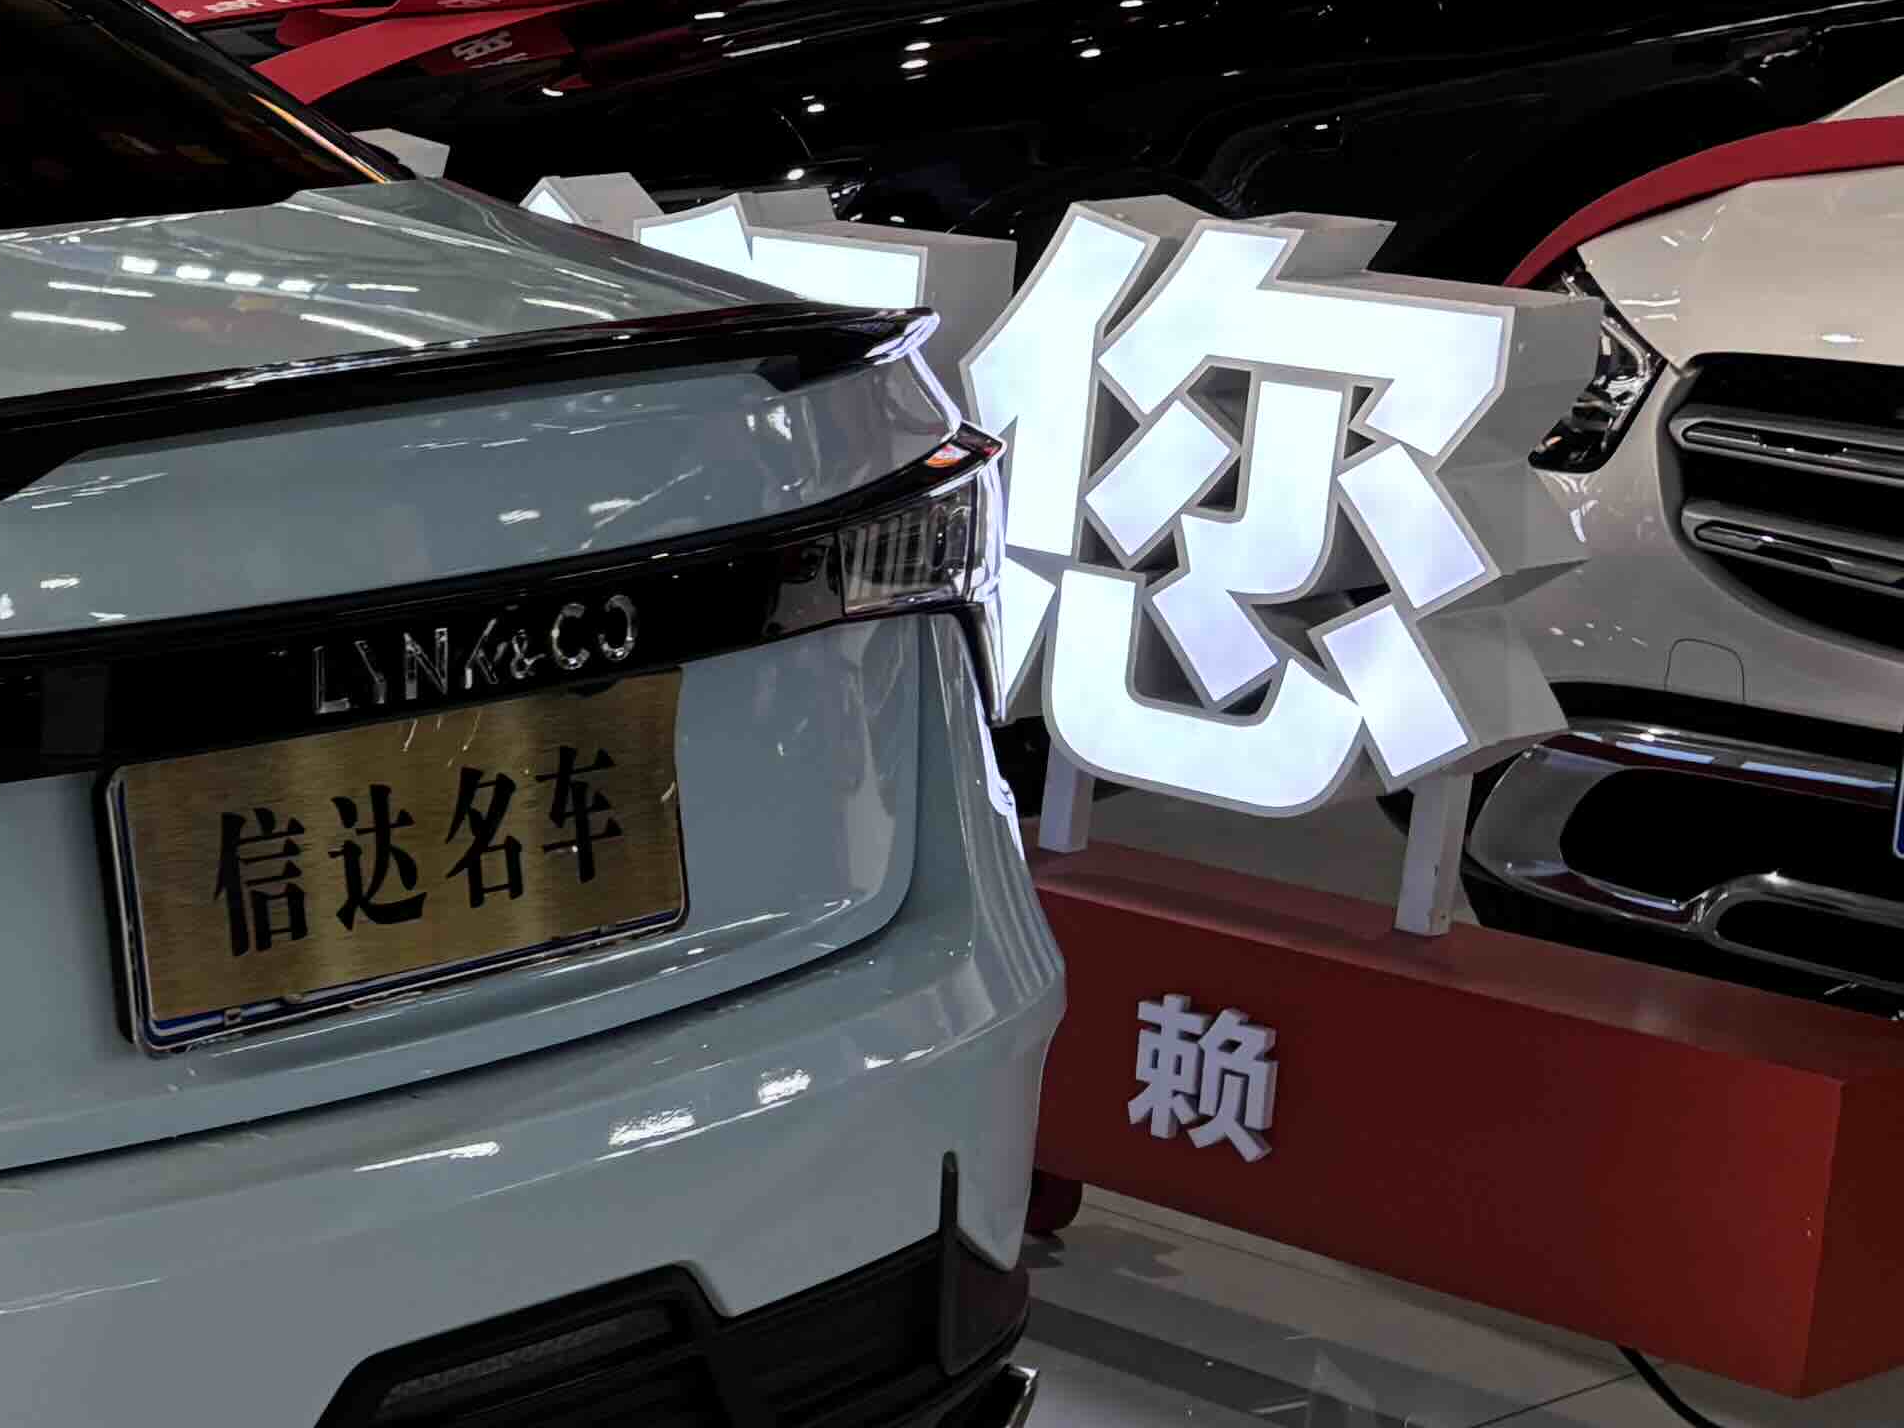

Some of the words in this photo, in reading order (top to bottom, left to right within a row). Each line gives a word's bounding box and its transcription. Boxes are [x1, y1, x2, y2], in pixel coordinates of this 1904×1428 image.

[212, 744, 623, 957] 信达名车
[1127, 992, 1279, 1164] 赖
